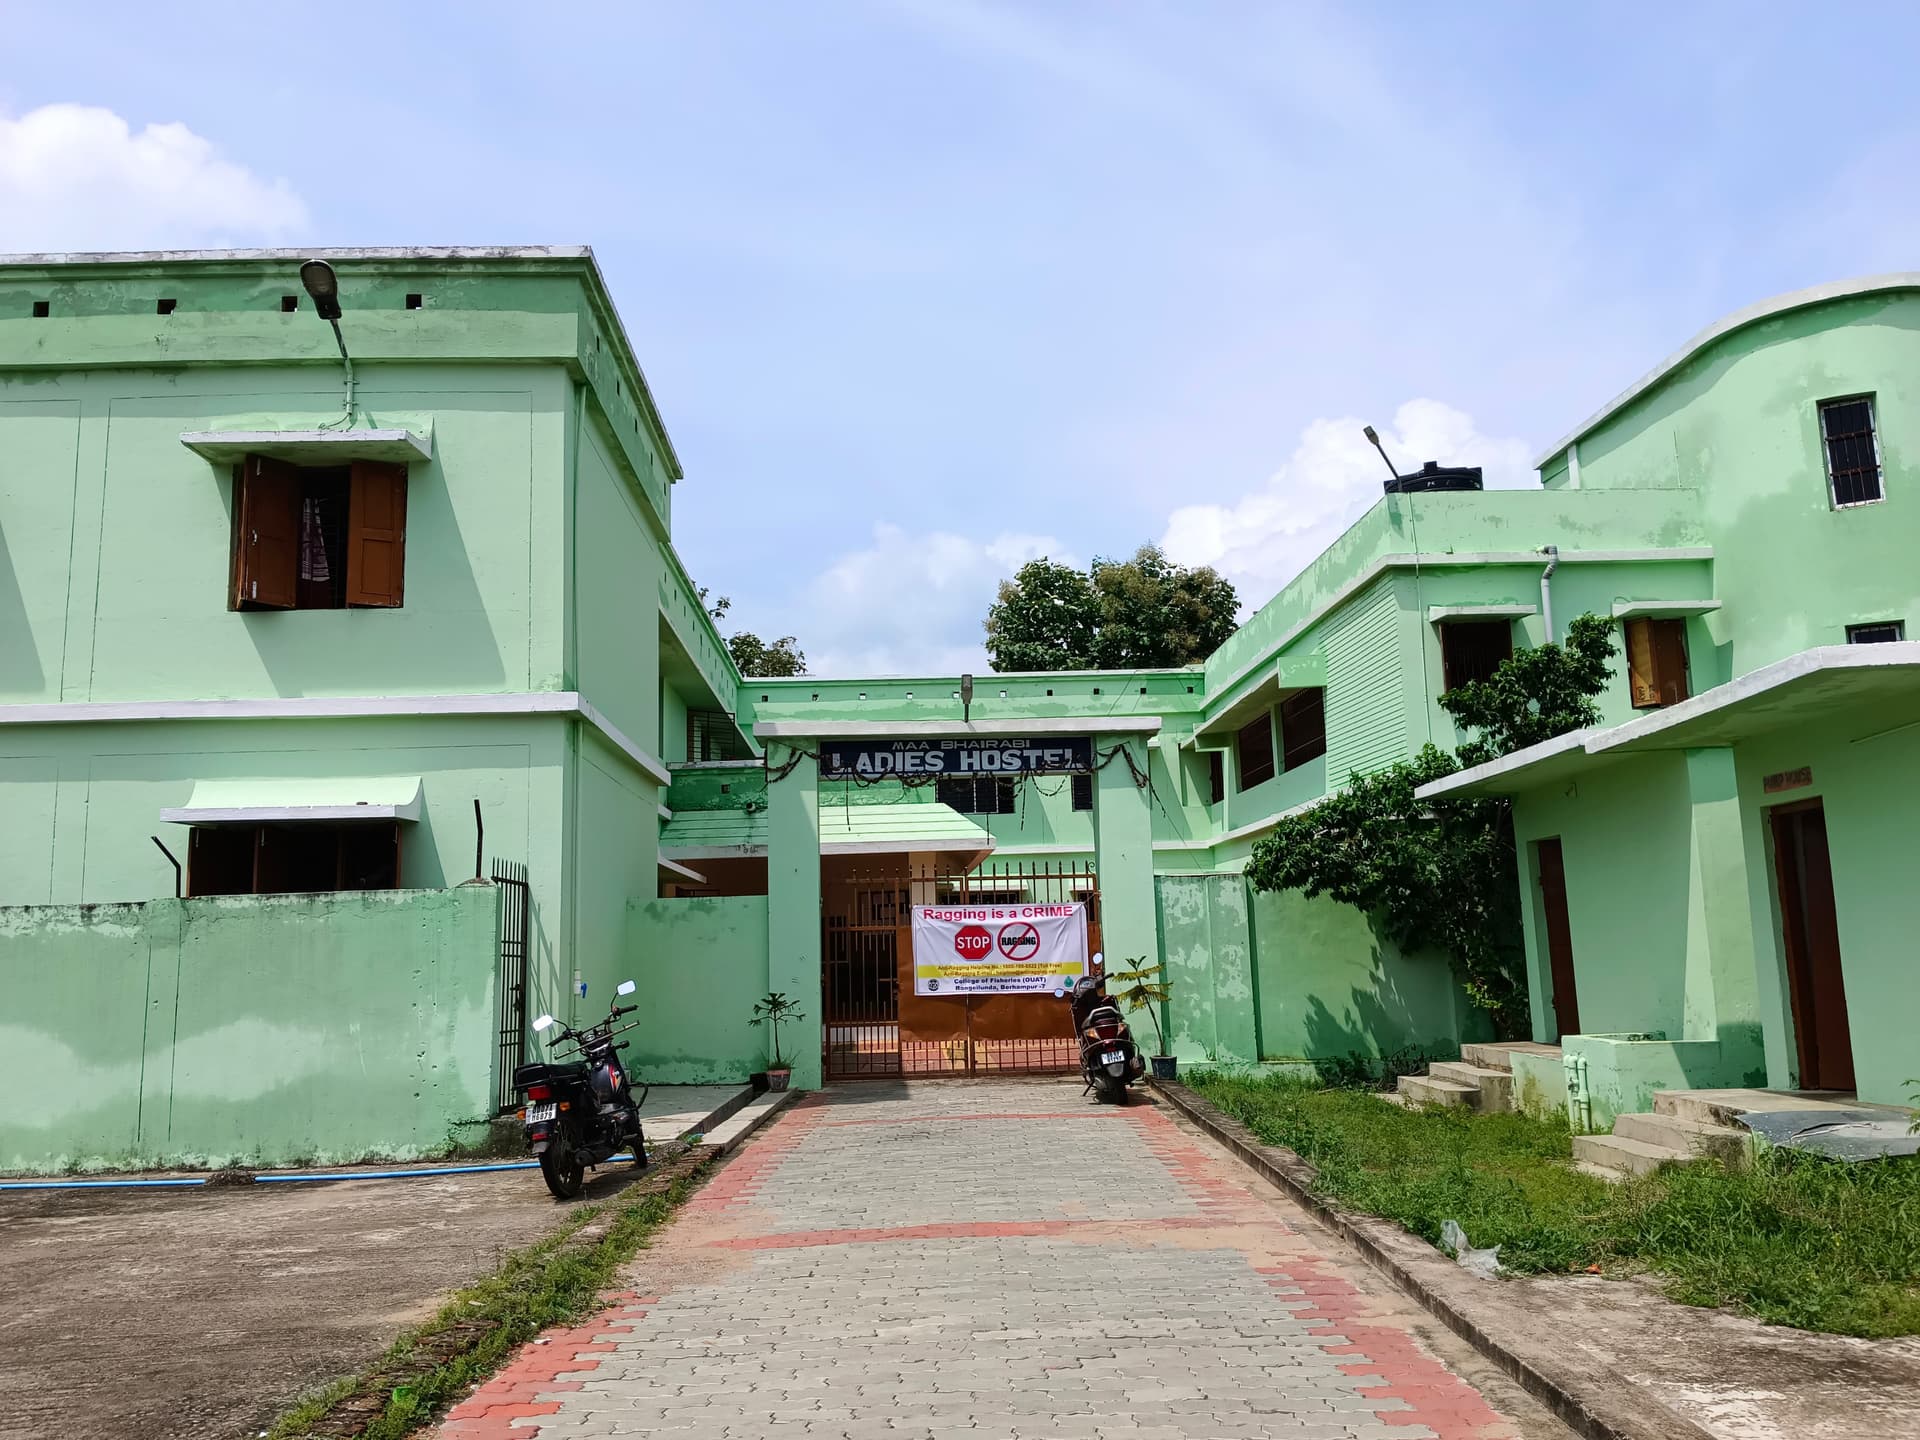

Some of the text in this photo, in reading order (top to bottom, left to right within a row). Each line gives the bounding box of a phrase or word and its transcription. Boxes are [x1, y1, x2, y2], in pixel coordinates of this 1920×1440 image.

[892, 739, 1030, 750] MAA BHAIRABI
[832, 751, 945, 773] LADIES
[923, 906, 1074, 922] Ragging is a CRIME
[957, 936, 990, 949] STOP
[1022, 976, 1047, 984] (OUAT)
